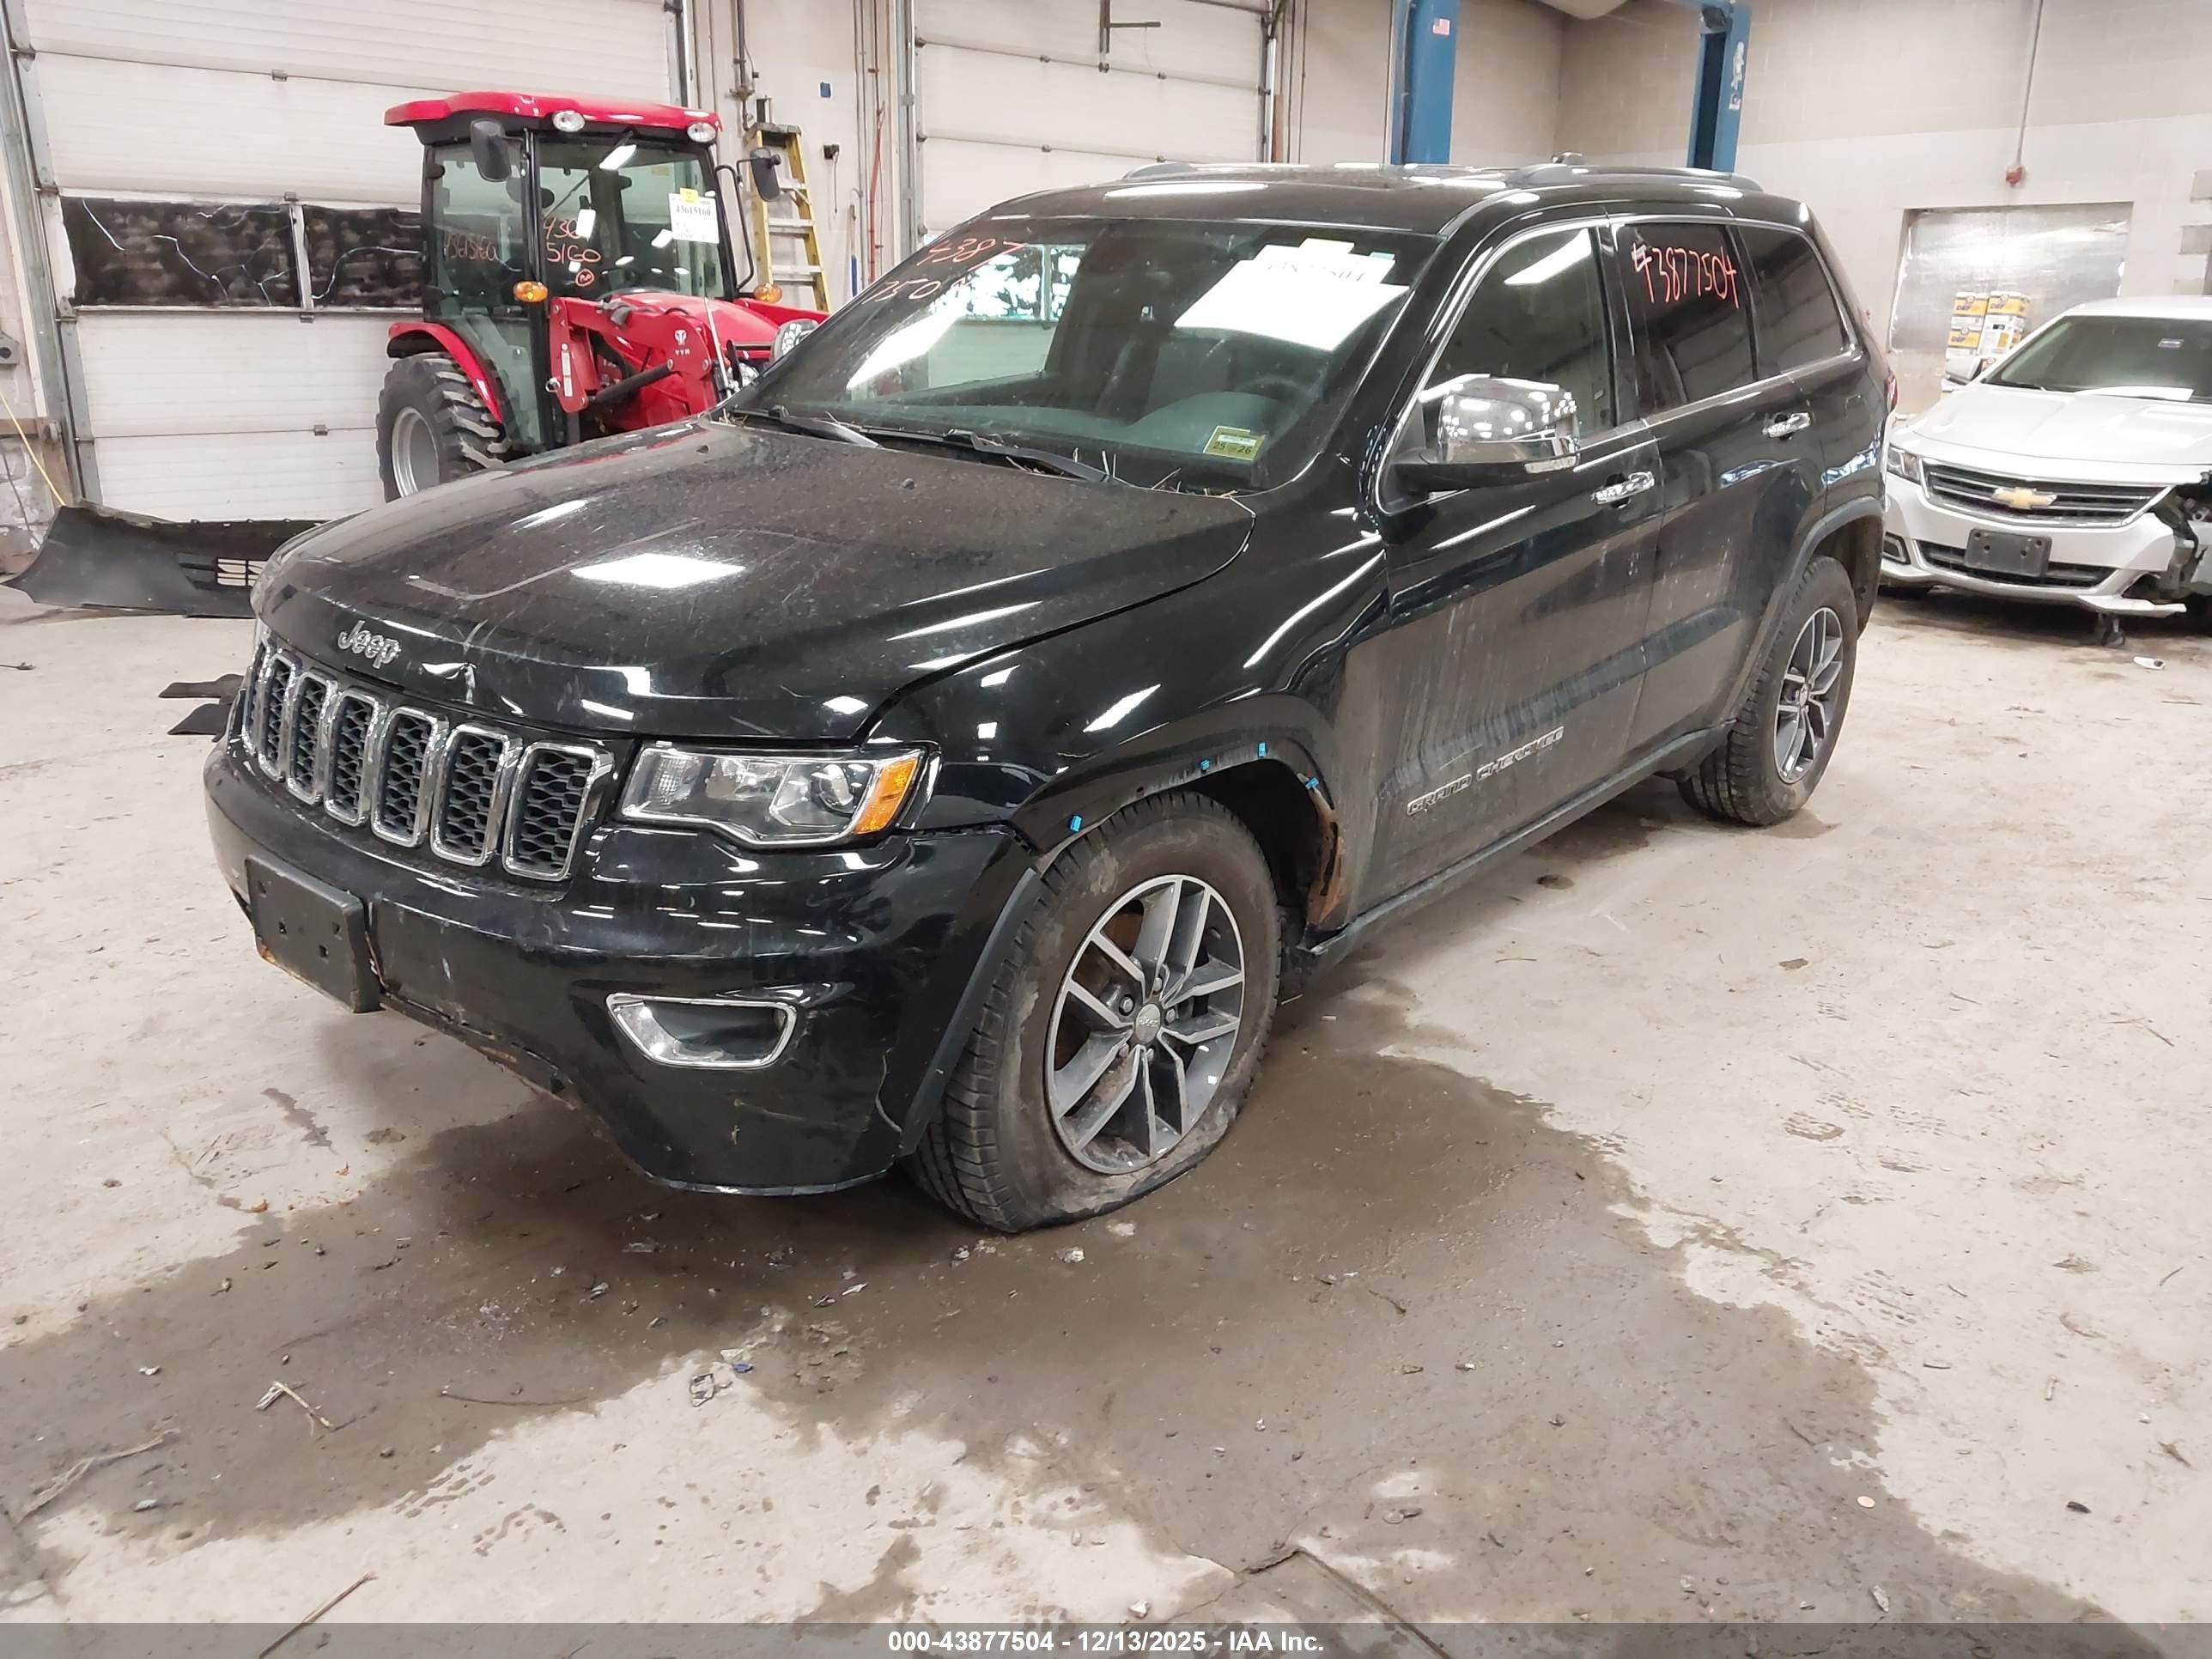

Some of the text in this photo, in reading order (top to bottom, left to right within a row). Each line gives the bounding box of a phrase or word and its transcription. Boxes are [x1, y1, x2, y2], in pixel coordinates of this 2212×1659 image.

[1632, 242, 1739, 309] 43877504
[1212, 441, 1251, 454] 25 26
[337, 620, 400, 669] Jeep
[1407, 774, 1473, 816] GRAND
